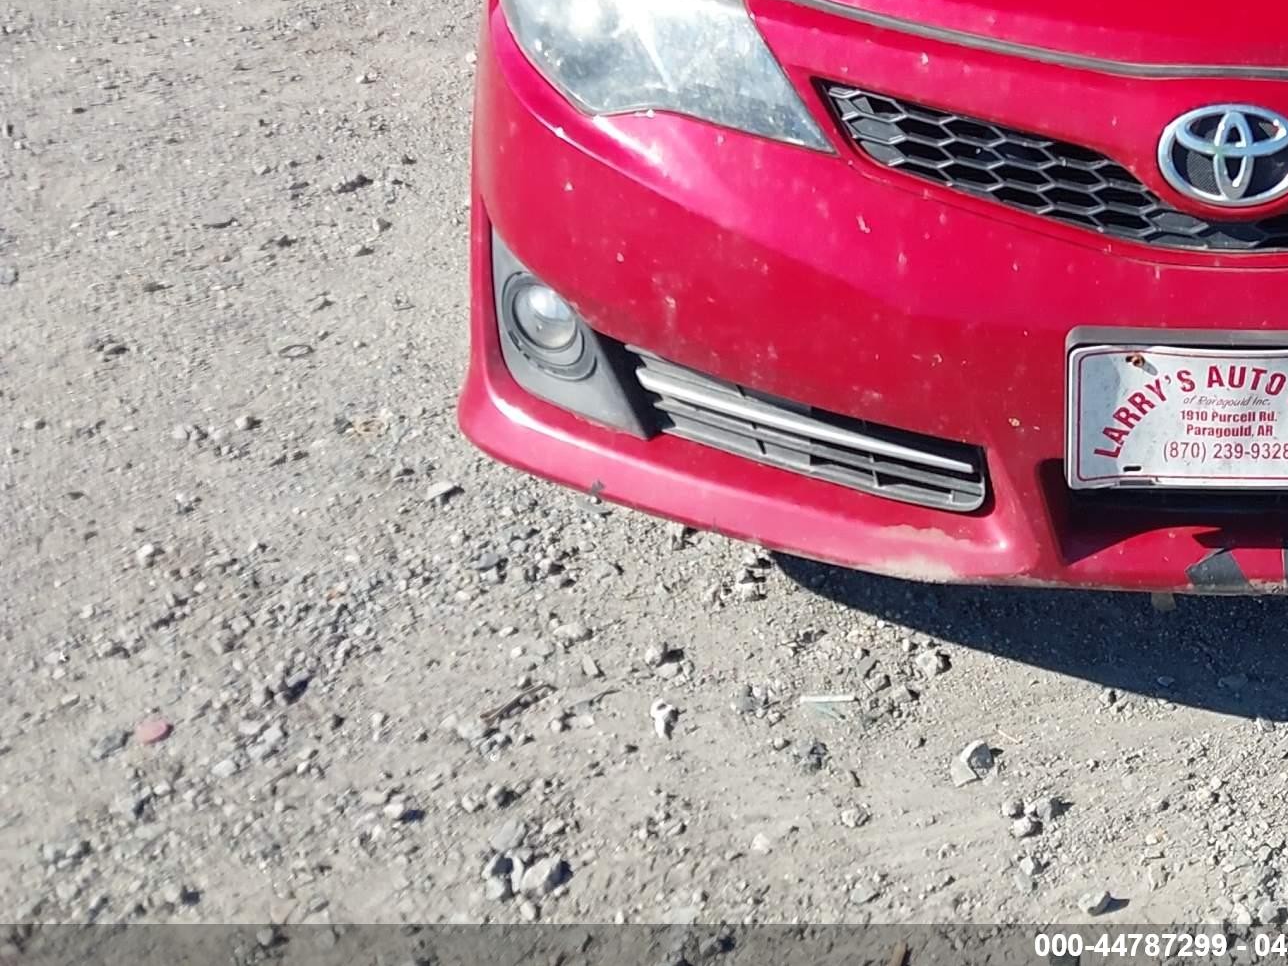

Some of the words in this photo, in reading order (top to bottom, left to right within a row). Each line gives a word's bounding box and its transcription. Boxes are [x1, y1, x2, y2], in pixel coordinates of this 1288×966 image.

[1183, 394, 1196, 405] of
[1198, 395, 1250, 408] Paragould
[1252, 396, 1271, 406] Inc.
[1094, 369, 1196, 459] LARRY'S
[1207, 365, 1287, 396] AUTO
[1181, 410, 1208, 421] 1910
[1211, 410, 1256, 422] Purcell
[1258, 411, 1278, 422] Rd.
[1186, 424, 1255, 438] Paragould,
[1257, 425, 1273, 436] AR
[1163, 441, 1207, 463] (870)
